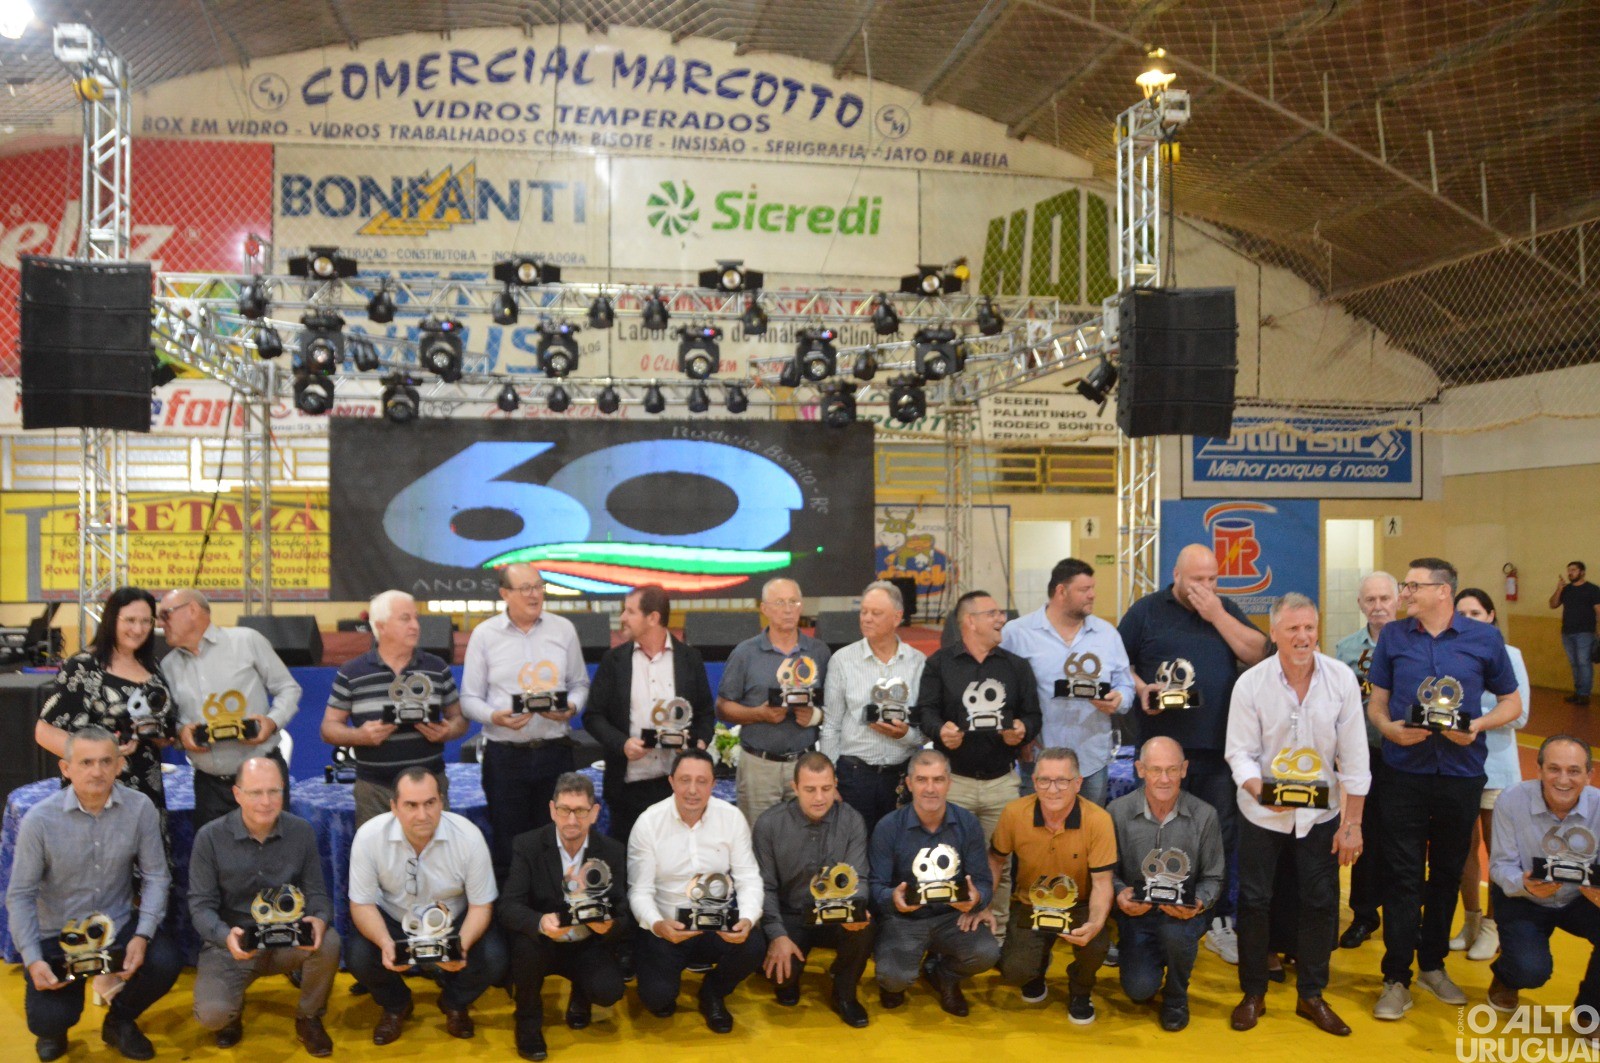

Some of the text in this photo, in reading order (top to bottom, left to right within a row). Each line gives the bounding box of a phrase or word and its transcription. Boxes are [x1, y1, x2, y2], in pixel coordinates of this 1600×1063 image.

[302, 46, 864, 128] COMERCIAL MARCOTTO
[413, 100, 771, 133] VIDROS TEMPERADOS
[142, 116, 183, 133] BOX
[190, 118, 218, 135] EM
[227, 120, 288, 136] VIDRO
[310, 122, 380, 139] VIDROS
[390, 123, 526, 143] TRABALHADOS
[591, 132, 653, 148] BISOTE
[672, 134, 746, 152] INSISÃO
[766, 140, 866, 159] SERIGRAFIA
[885, 148, 928, 162] JATO
[934, 150, 954, 164] DE
[961, 151, 1009, 168] AREIA
[280, 174, 586, 223] BONFANTI
[712, 190, 882, 235] Sicredi
[393, 248, 476, 262] CONSTRUTORA
[993, 397, 1049, 406] SEBERI
[993, 409, 1087, 419] PALMITINHO
[993, 420, 1114, 431] RODEIO BONITO
[1207, 460, 1388, 480] Melhor porque é nosso
[382, 440, 803, 569] 60
[411, 578, 498, 593] ANOS
